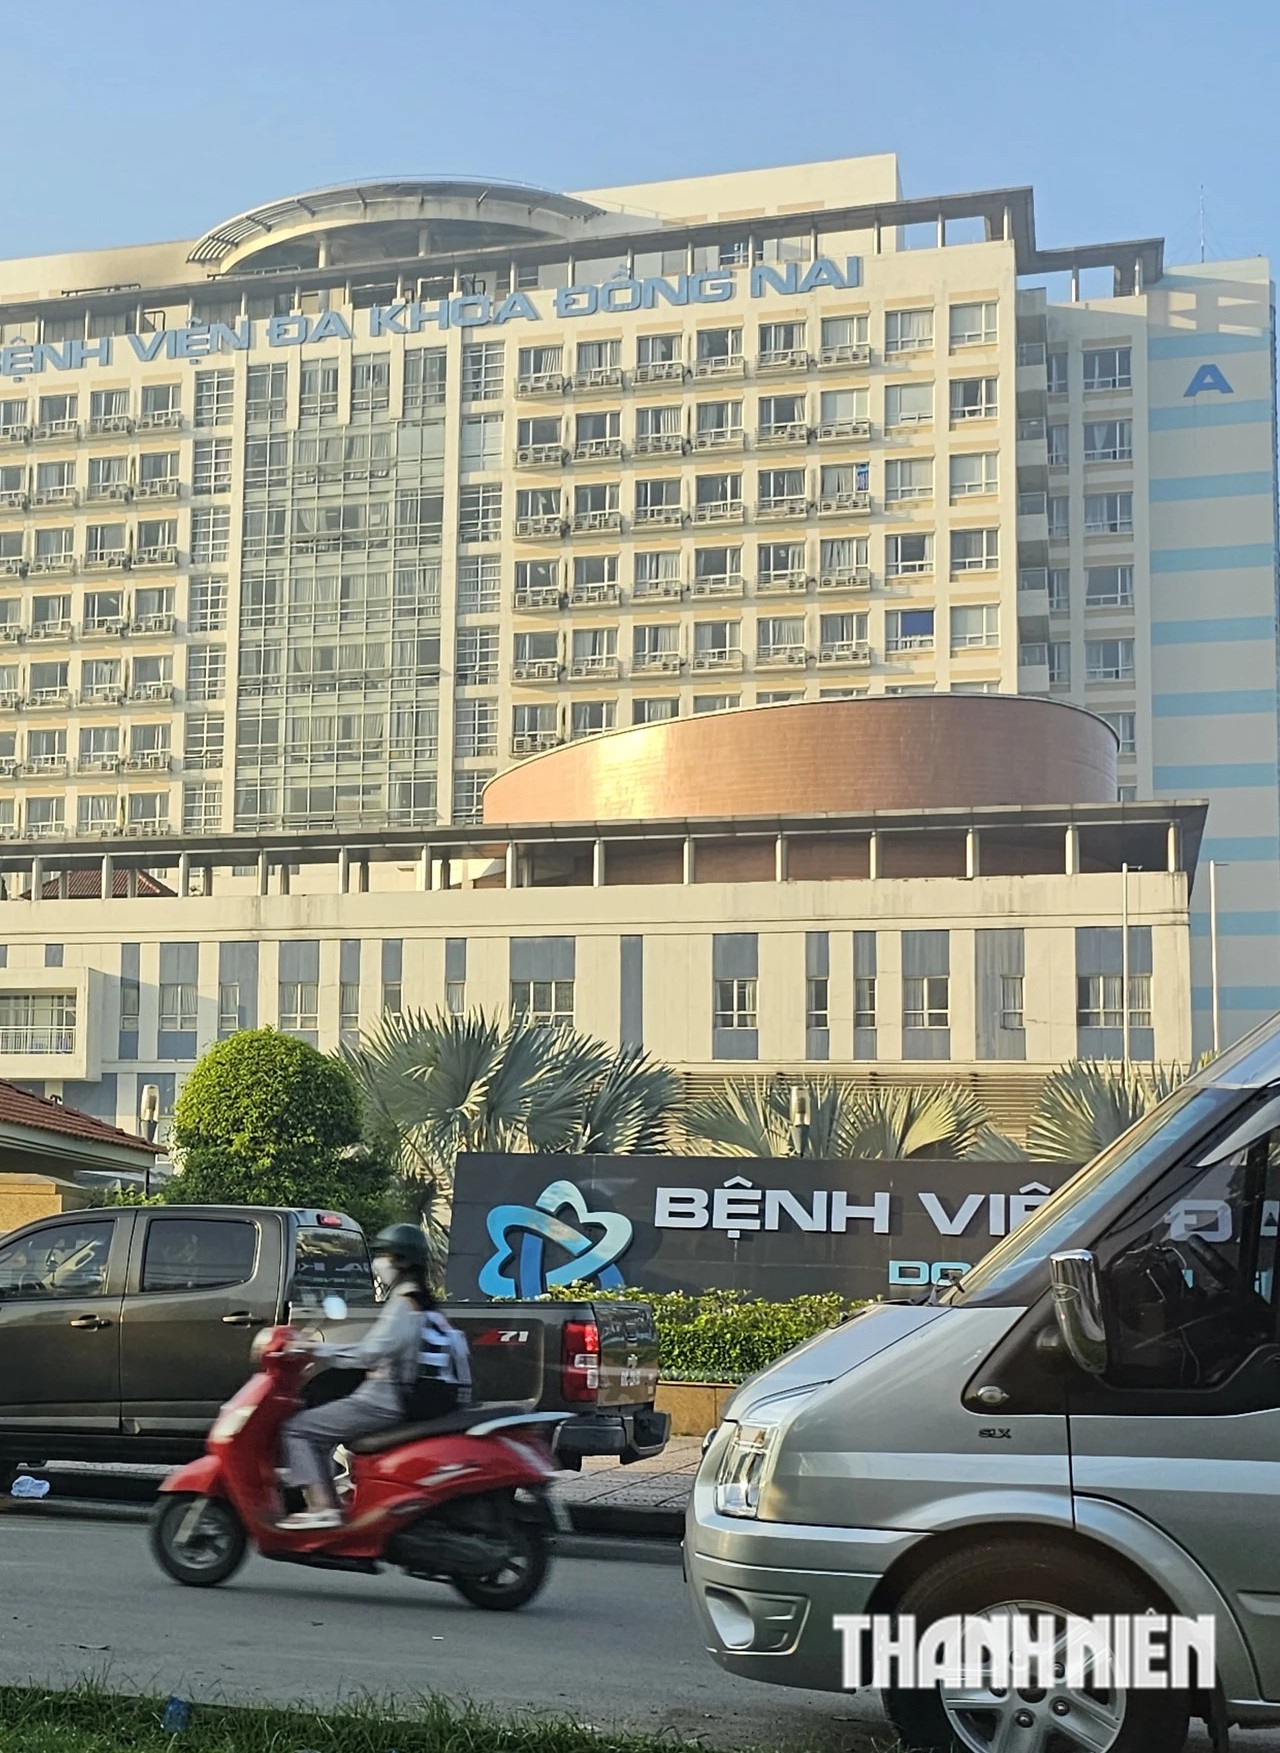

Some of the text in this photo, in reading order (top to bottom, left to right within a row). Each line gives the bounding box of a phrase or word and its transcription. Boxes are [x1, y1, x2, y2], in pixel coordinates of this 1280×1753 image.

[128, 318, 253, 366] VIỆN
[266, 310, 352, 347] ĐA
[370, 291, 541, 338] KHOA
[751, 255, 860, 298] NAI
[1183, 364, 1234, 398] A
[654, 1174, 891, 1239] BỆNH
[888, 1260, 971, 1286] DO
